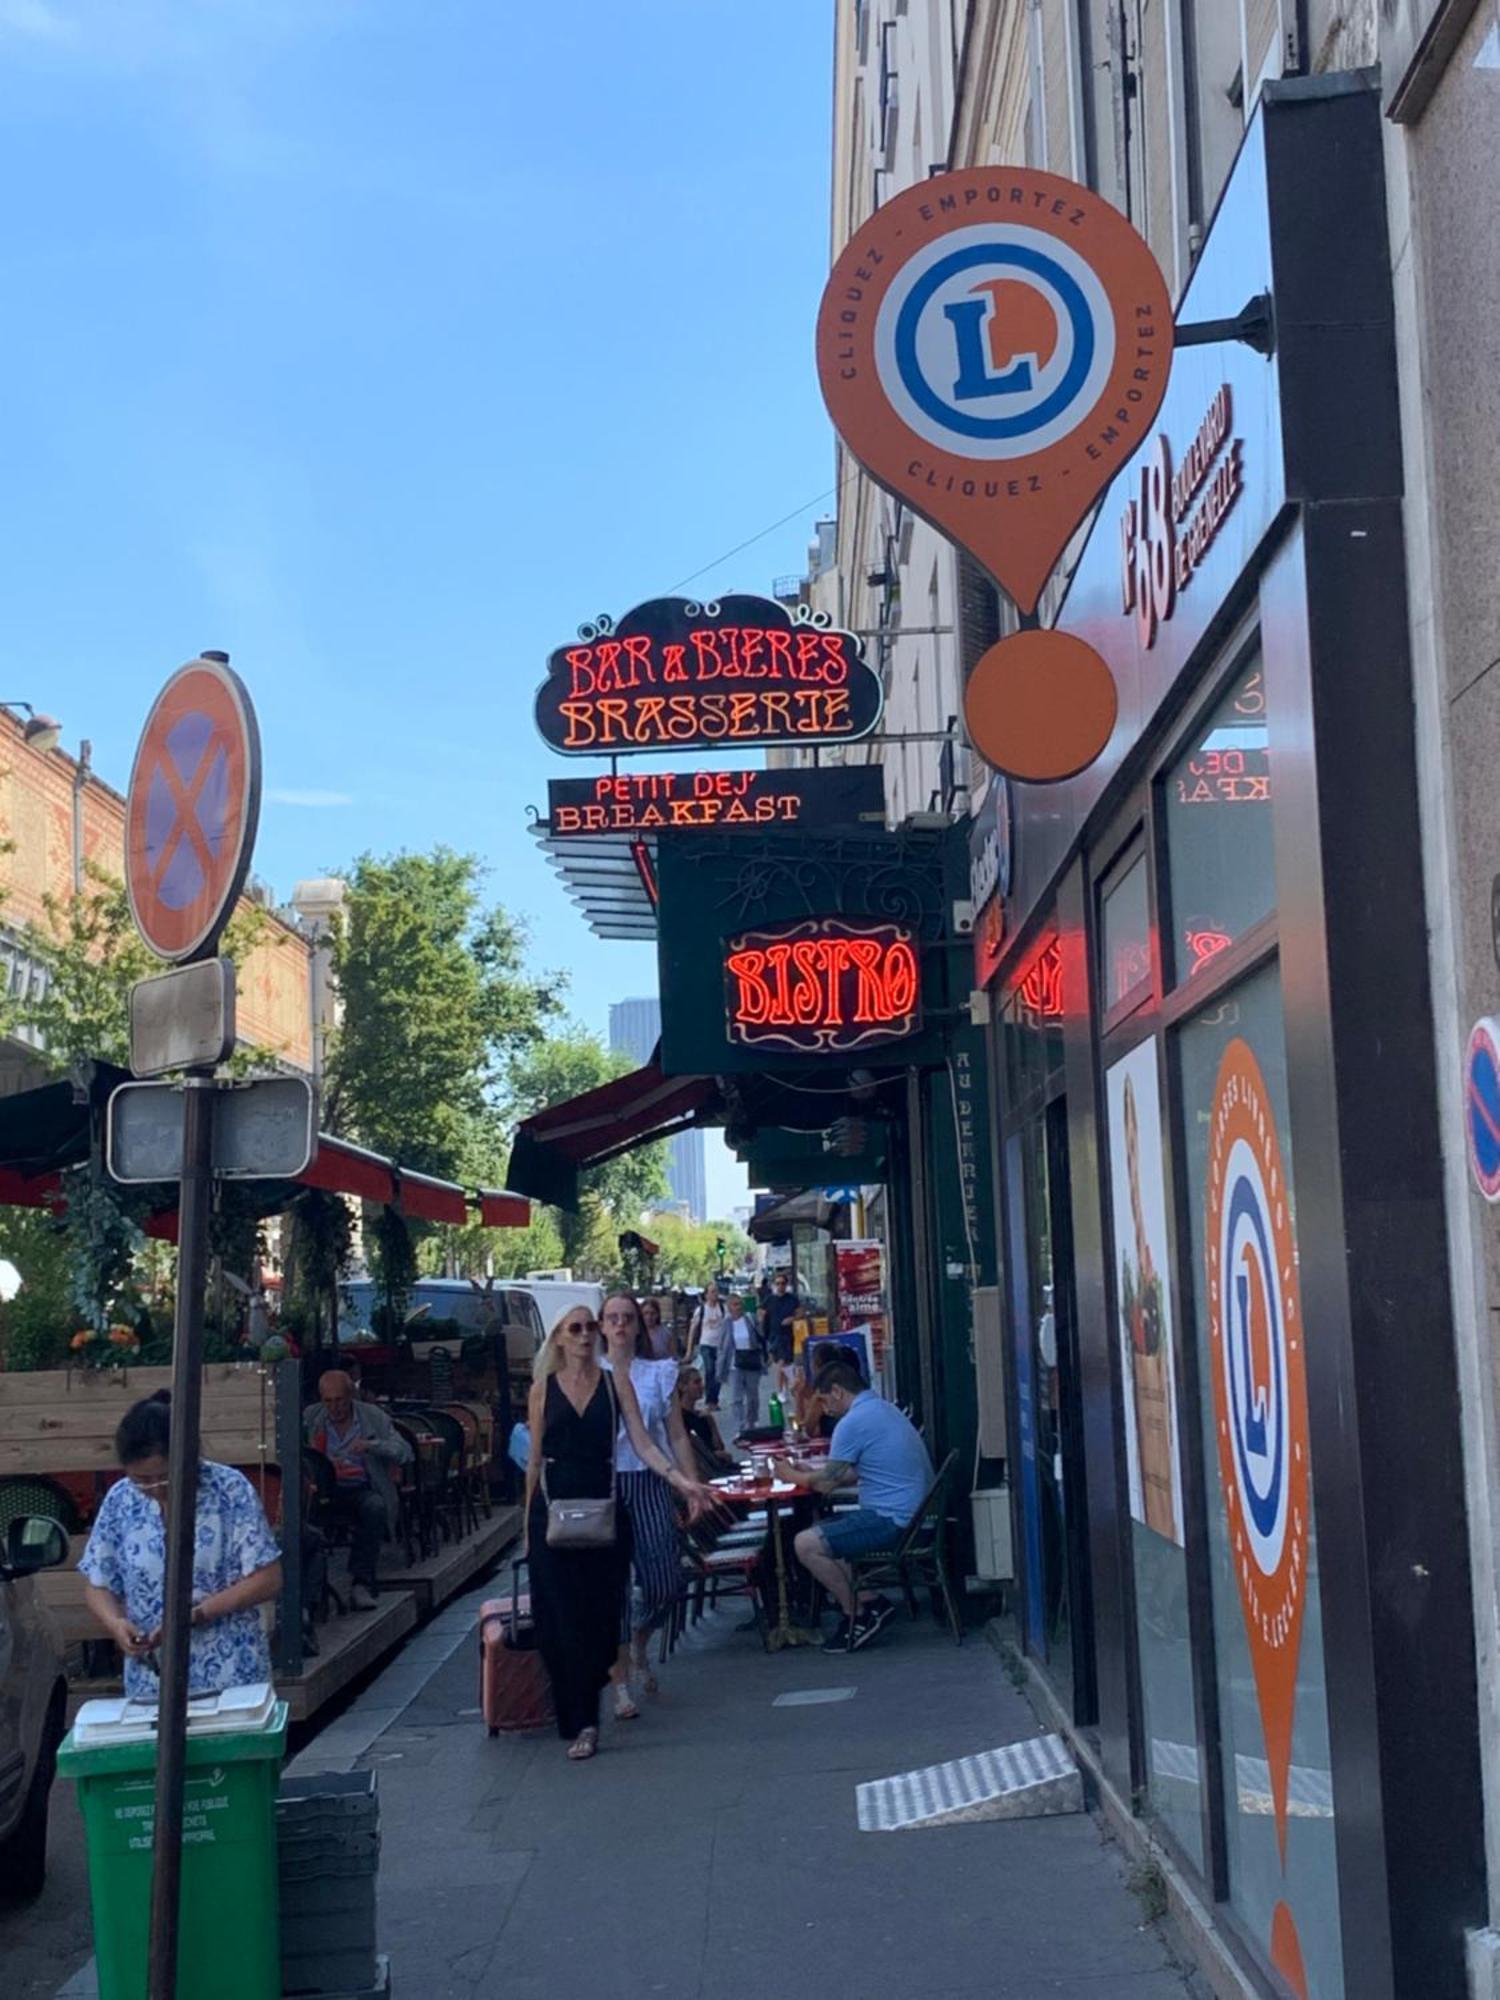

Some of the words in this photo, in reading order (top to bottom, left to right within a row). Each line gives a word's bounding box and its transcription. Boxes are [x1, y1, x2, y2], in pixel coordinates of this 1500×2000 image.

[840, 247, 884, 381] CLIQUEZ
[919, 186, 1086, 226] EMPORTEZ
[908, 460, 1042, 498] CLIQUEZ
[1086, 303, 1154, 461] EMPORTEZ
[565, 634, 657, 700] BAR
[689, 628, 849, 685] BIERES
[559, 689, 854, 747] BRASSERIE
[556, 795, 802, 832] BREAKFAST
[595, 774, 676, 801] PETIT
[727, 938, 918, 1026] BISTRO
